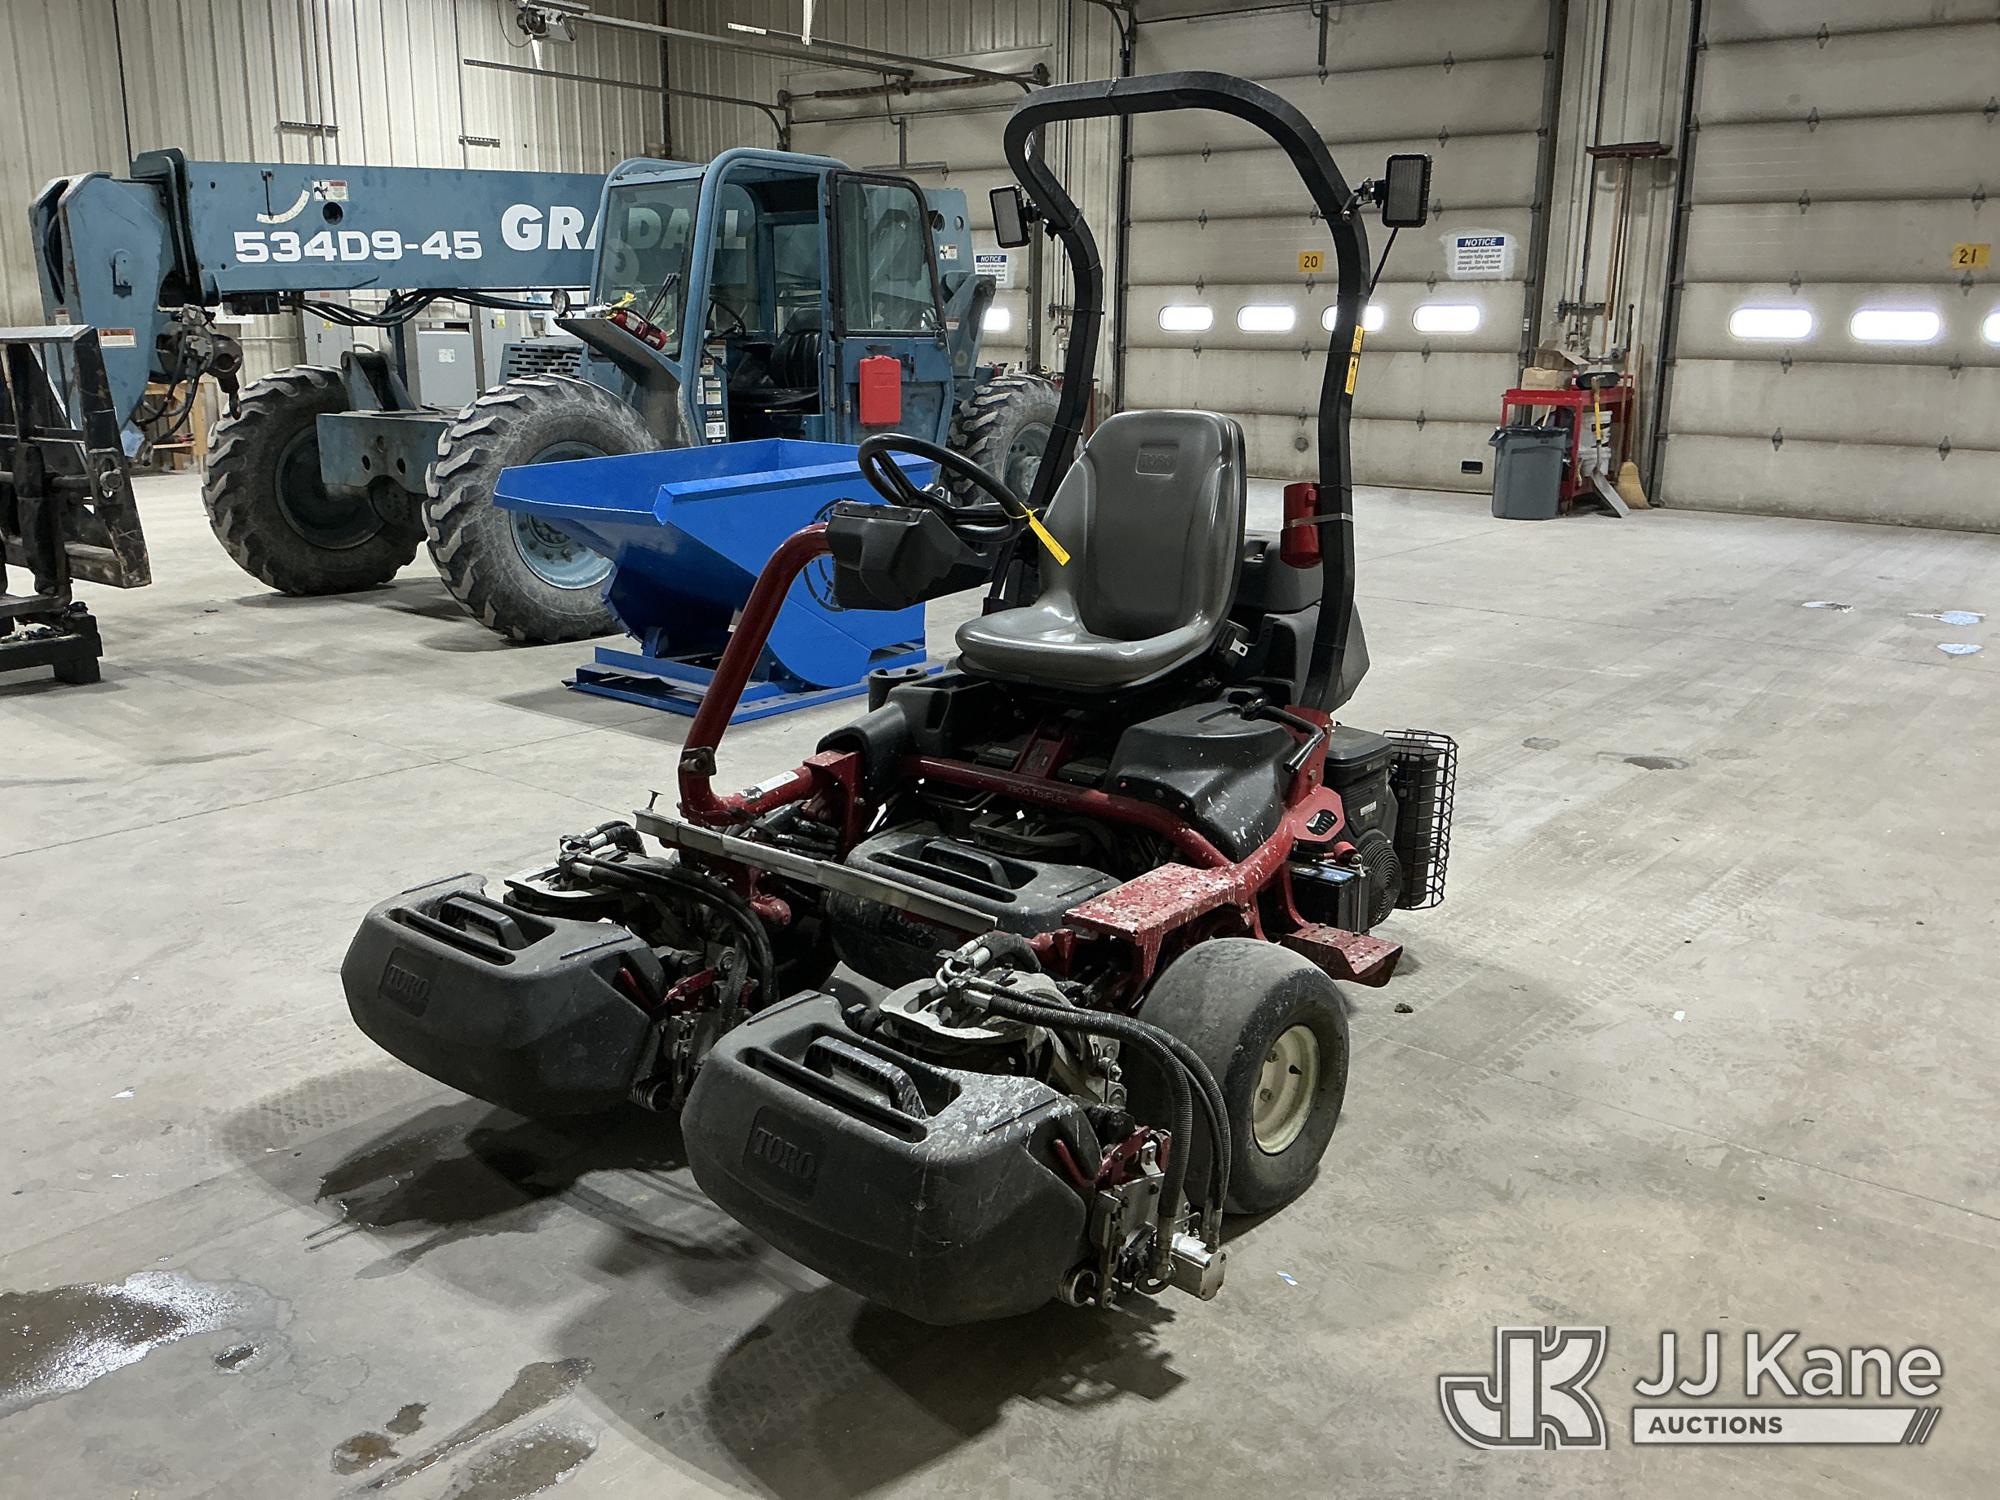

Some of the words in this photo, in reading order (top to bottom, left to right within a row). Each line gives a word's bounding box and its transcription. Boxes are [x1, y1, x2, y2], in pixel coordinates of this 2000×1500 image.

[501, 203, 748, 251] GRDAL
[1464, 238, 1496, 246] NOTICE
[233, 230, 483, 263] 534D9-45
[1304, 255, 1318, 268] 20
[1959, 248, 1977, 264] 21
[386, 963, 430, 999] TORO
[753, 1127, 818, 1181] TORO
